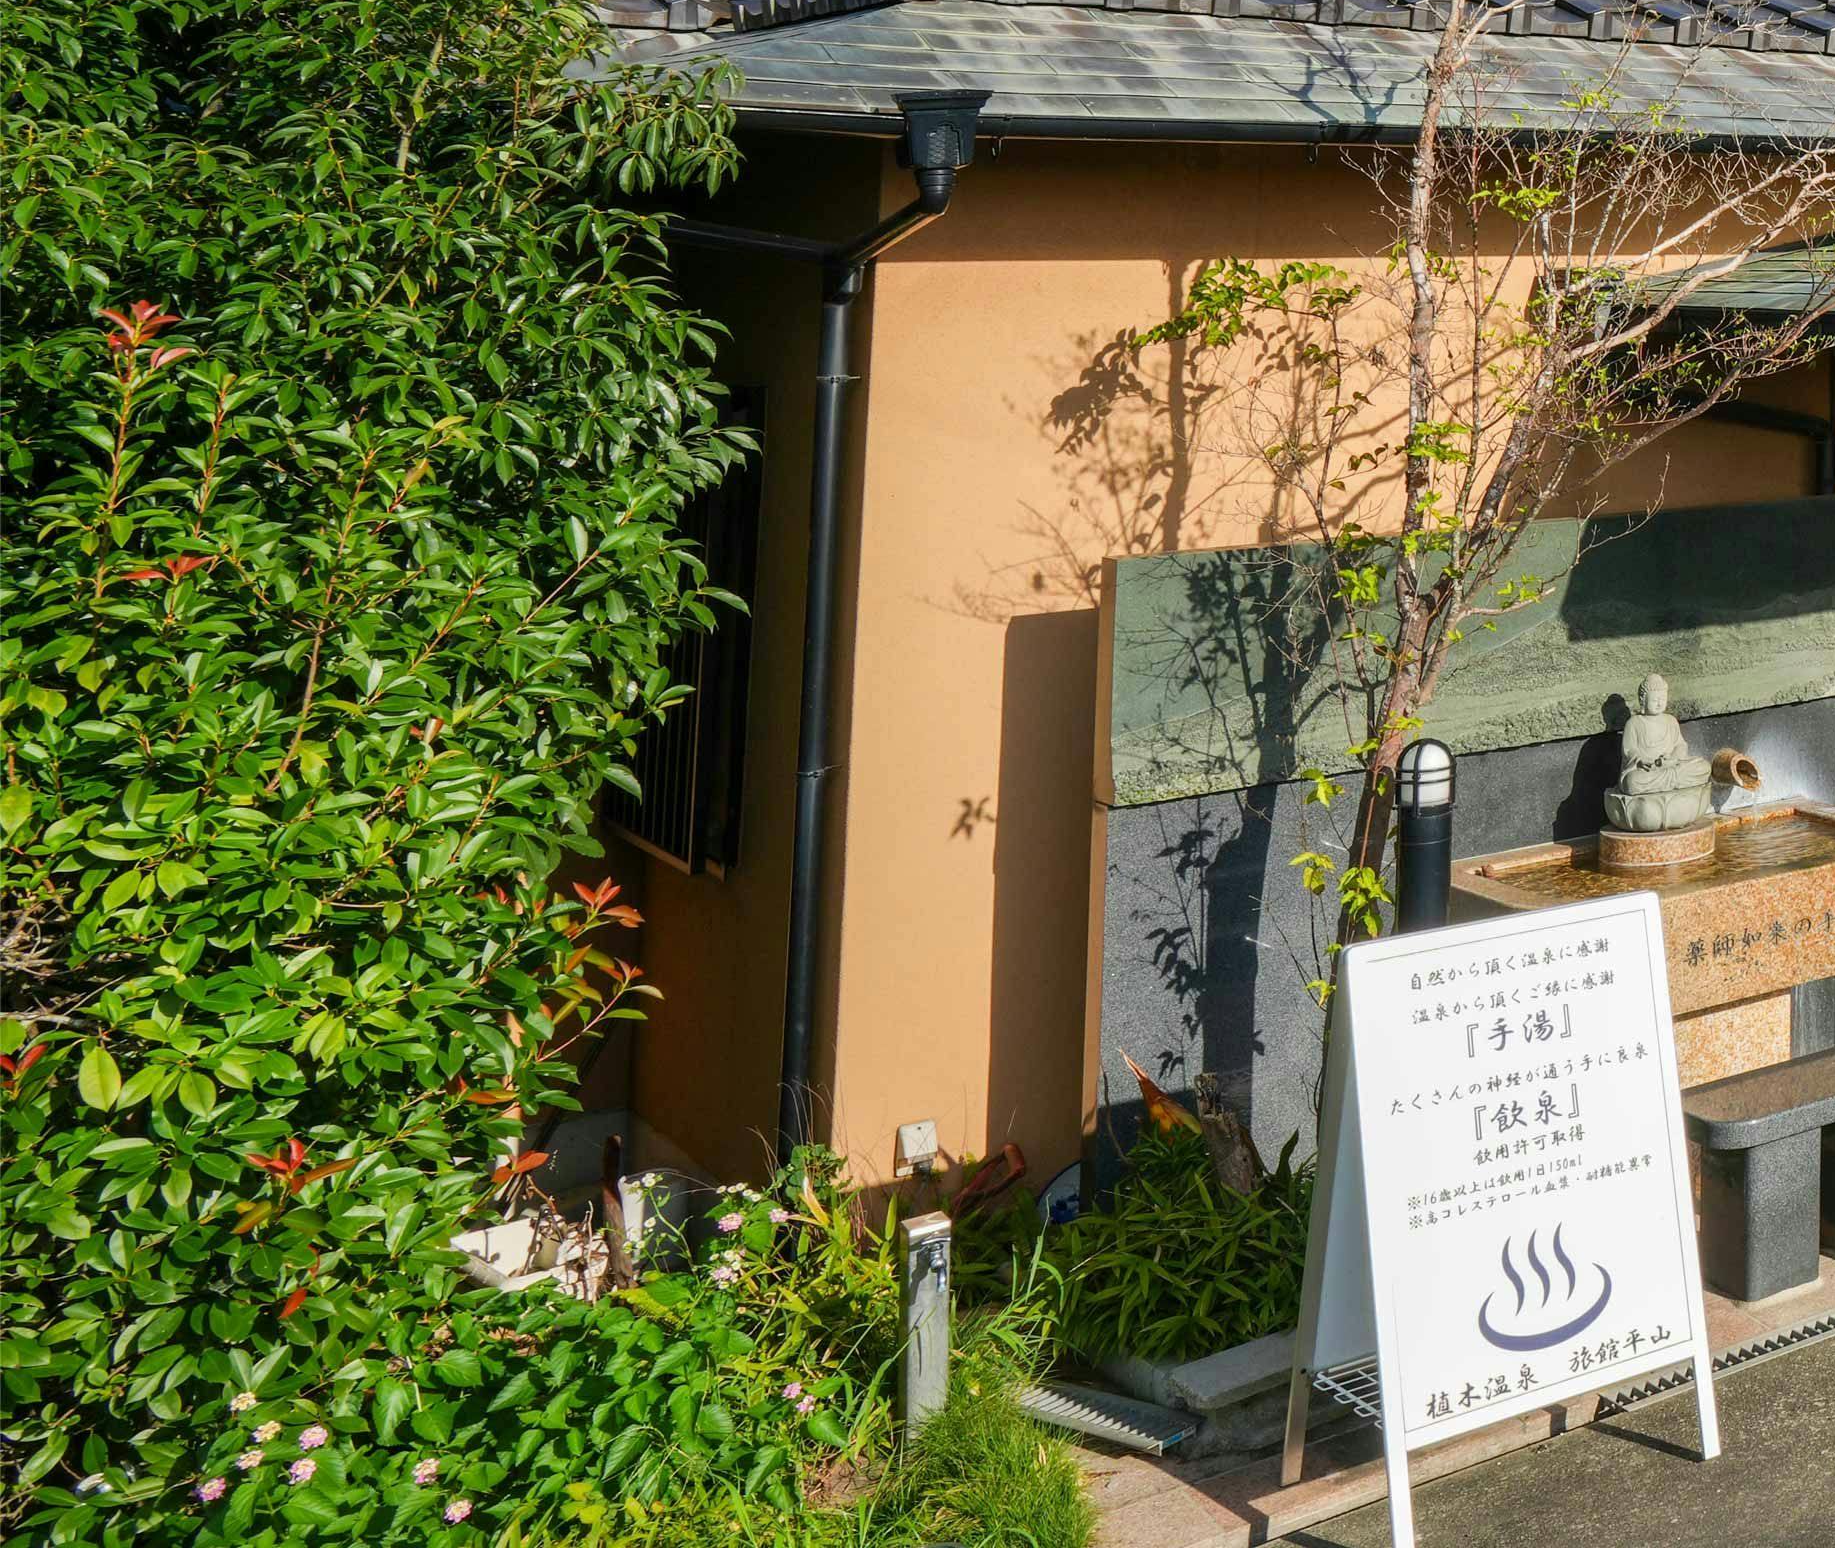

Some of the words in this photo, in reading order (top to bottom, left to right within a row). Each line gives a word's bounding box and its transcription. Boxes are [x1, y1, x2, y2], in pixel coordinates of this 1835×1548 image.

[1410, 938, 1609, 990] 自然から頂く温泉に感謝
[1412, 970, 1615, 1025] 温泉から頂くご縁に感謝
[1473, 1124, 1585, 1166] 飲用許可取得
